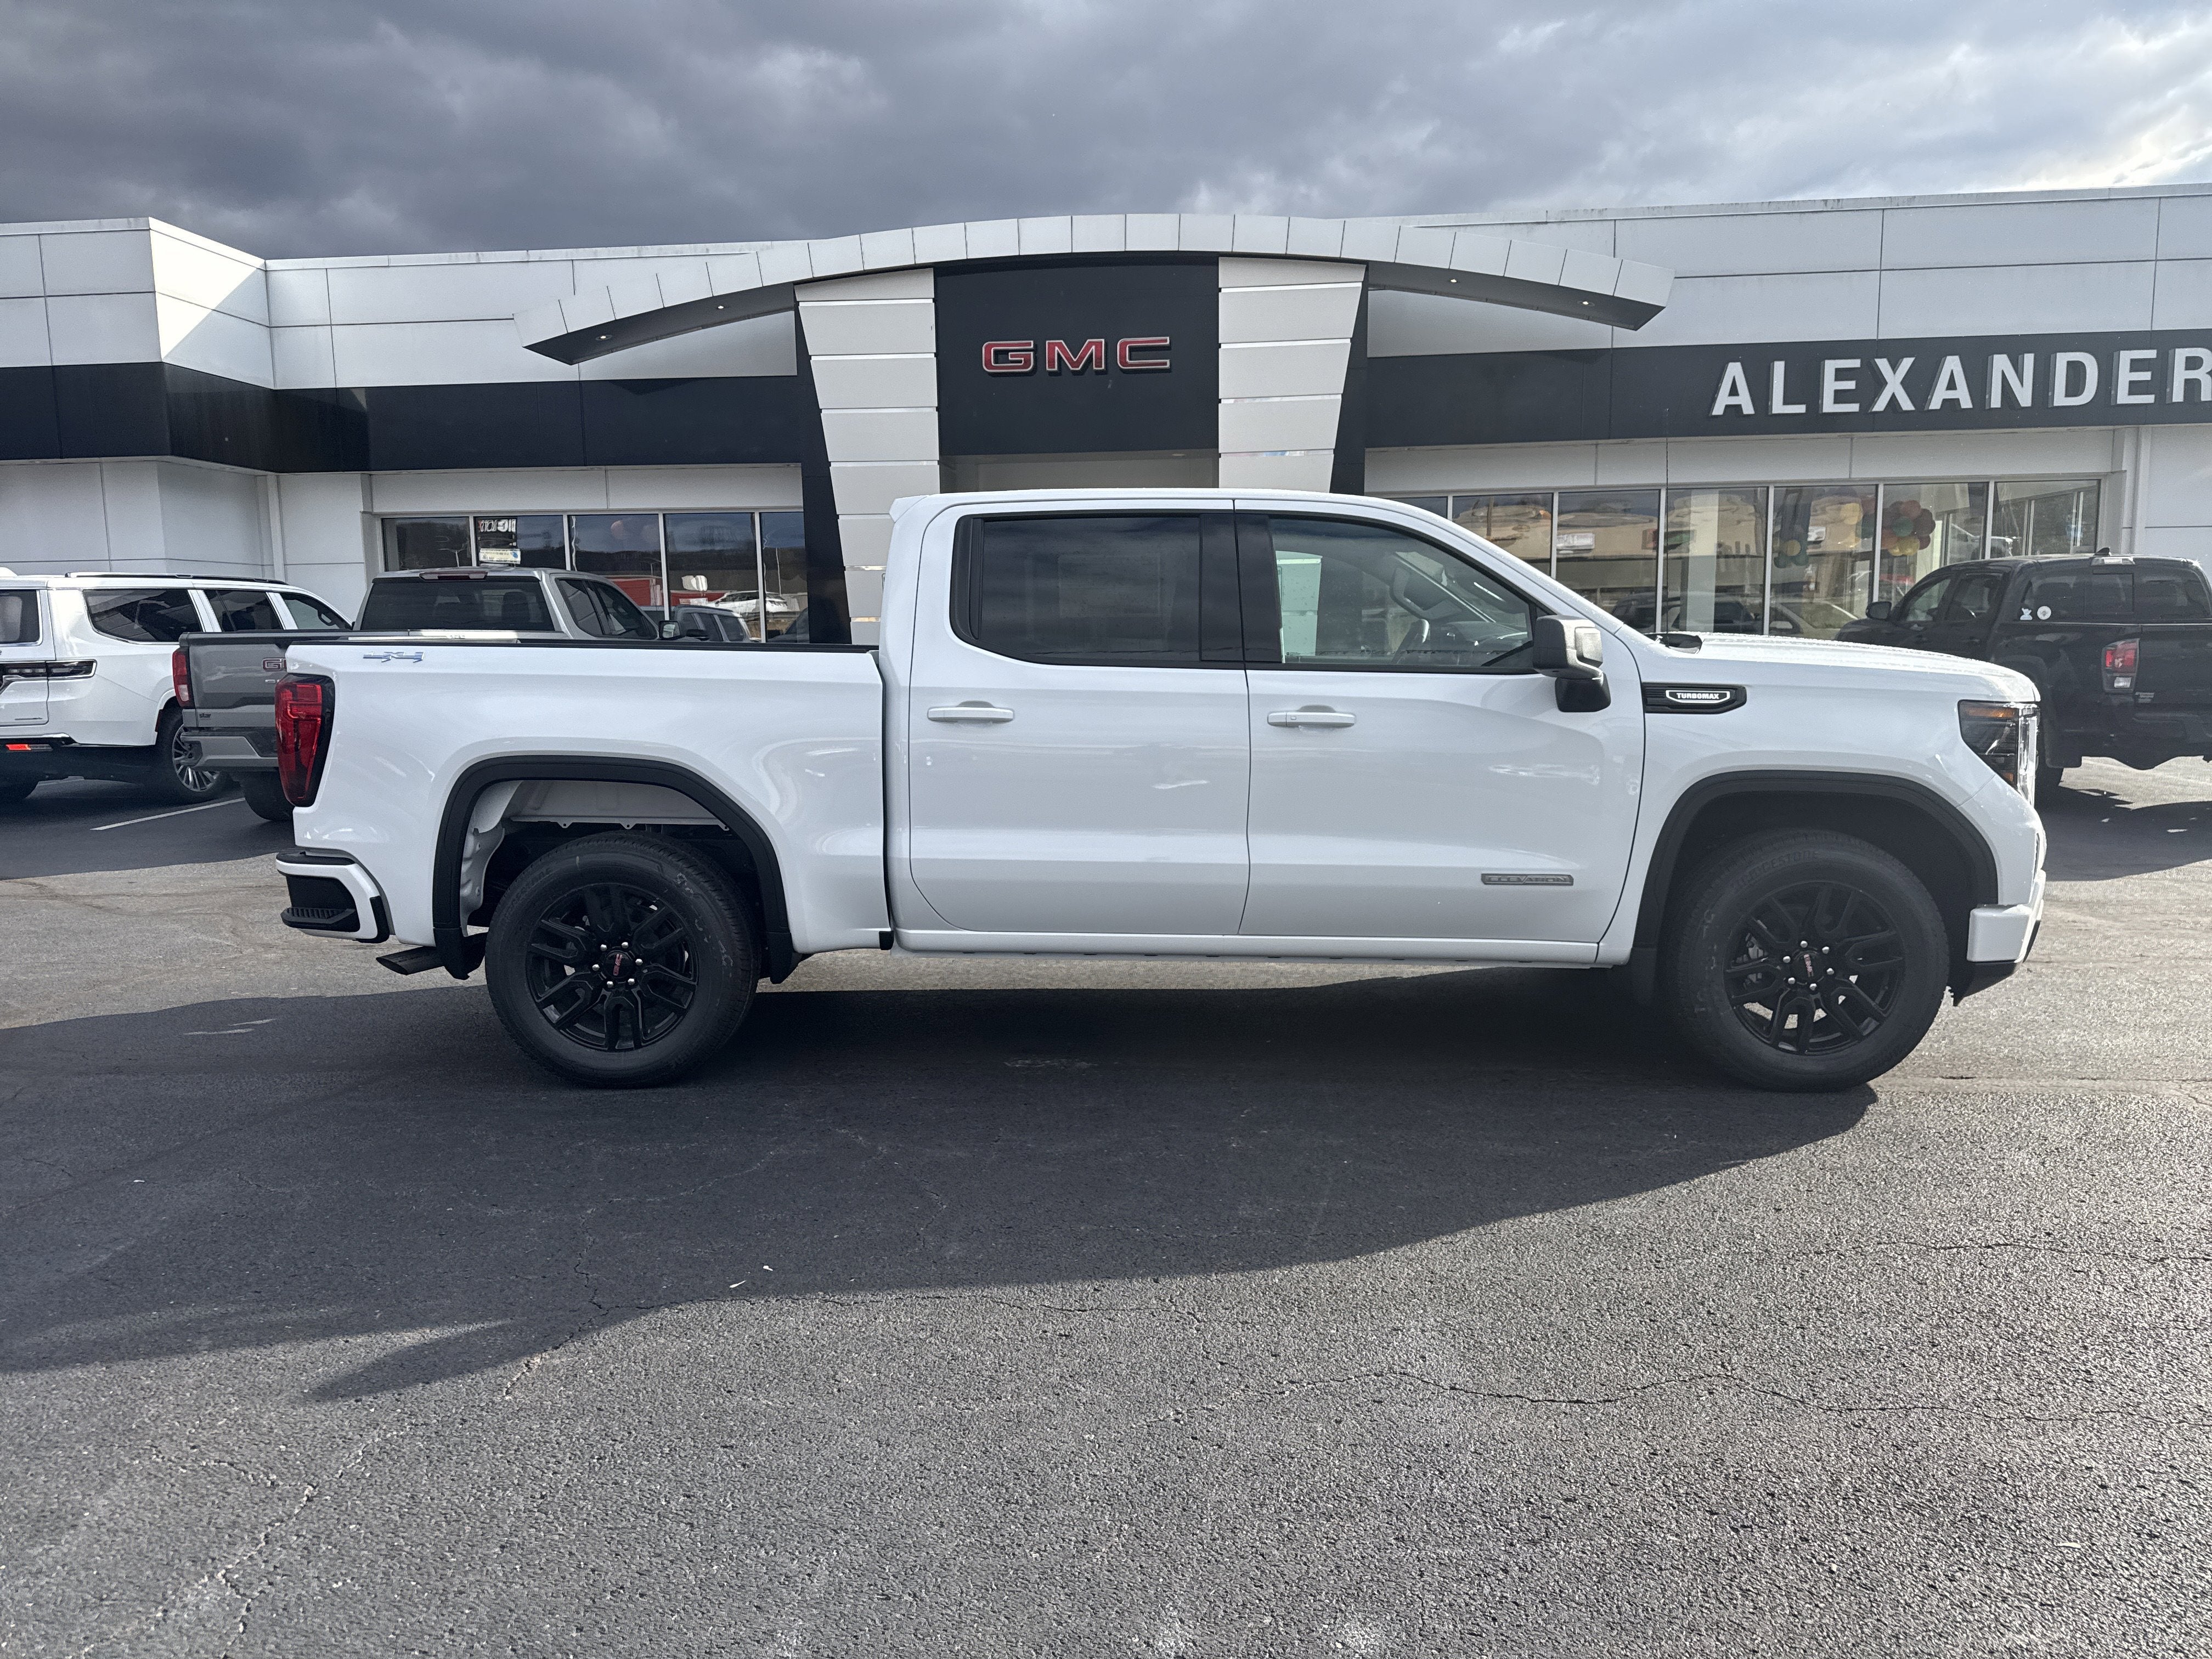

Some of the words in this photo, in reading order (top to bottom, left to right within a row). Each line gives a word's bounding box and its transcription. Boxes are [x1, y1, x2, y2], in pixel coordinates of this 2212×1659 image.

[982, 336, 1170, 373] GMC
[1711, 347, 2212, 415] ALEXANDER
[1487, 874, 1570, 883] ELEVATION
